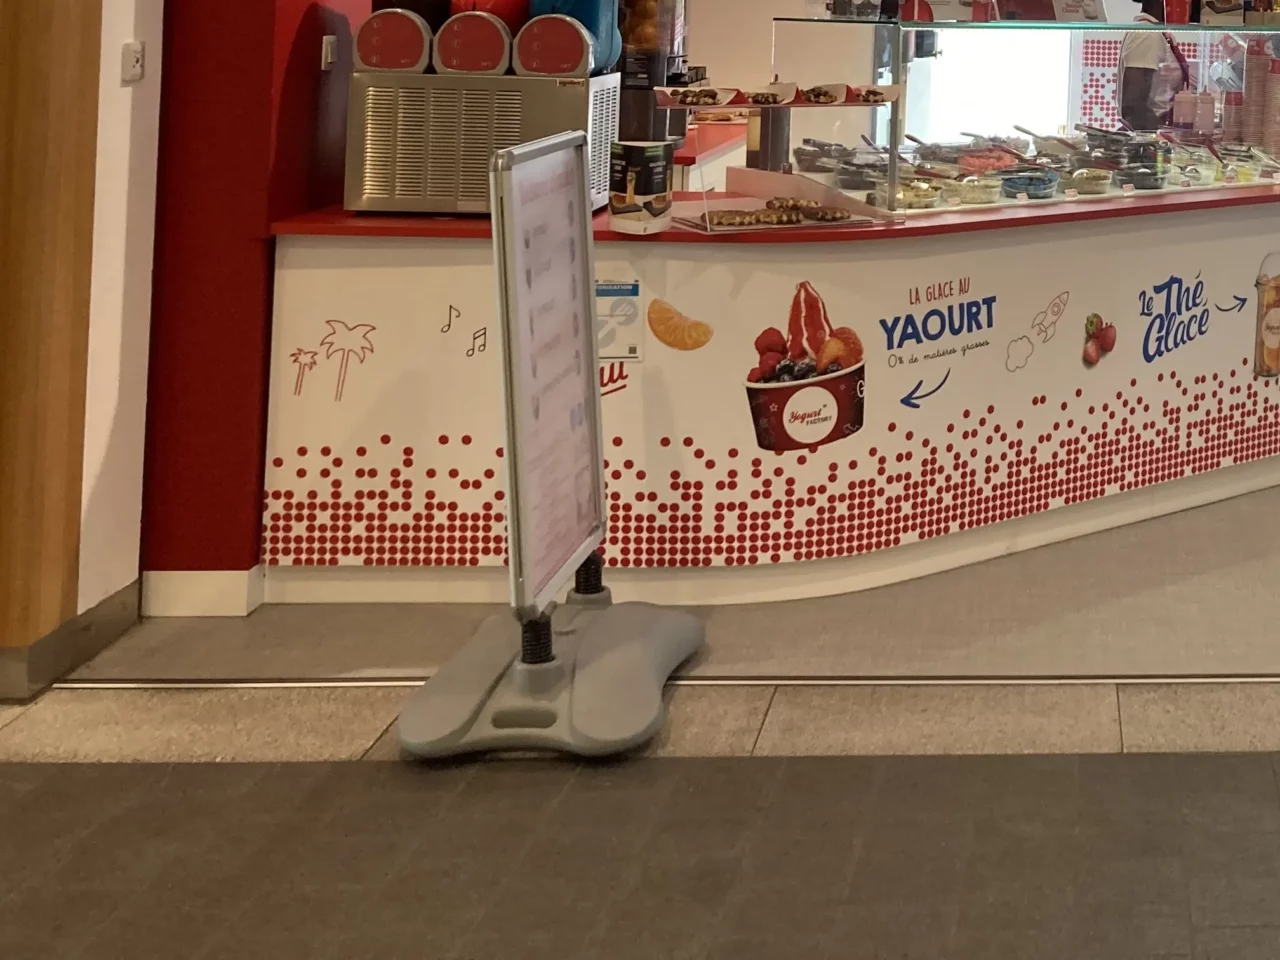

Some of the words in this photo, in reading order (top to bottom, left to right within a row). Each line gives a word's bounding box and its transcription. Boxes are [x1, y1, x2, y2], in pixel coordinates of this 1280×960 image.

[909, 287, 921, 305] LA
[926, 280, 954, 302] GLACE
[959, 277, 970, 296] AU
[1139, 290, 1153, 317] Le
[1153, 269, 1204, 319] Thé
[879, 295, 996, 350] YAOURT
[1143, 298, 1209, 363] Glacé
[908, 354, 919, 364] de
[961, 340, 990, 356] grasses
[788, 407, 822, 423] Yogurt
